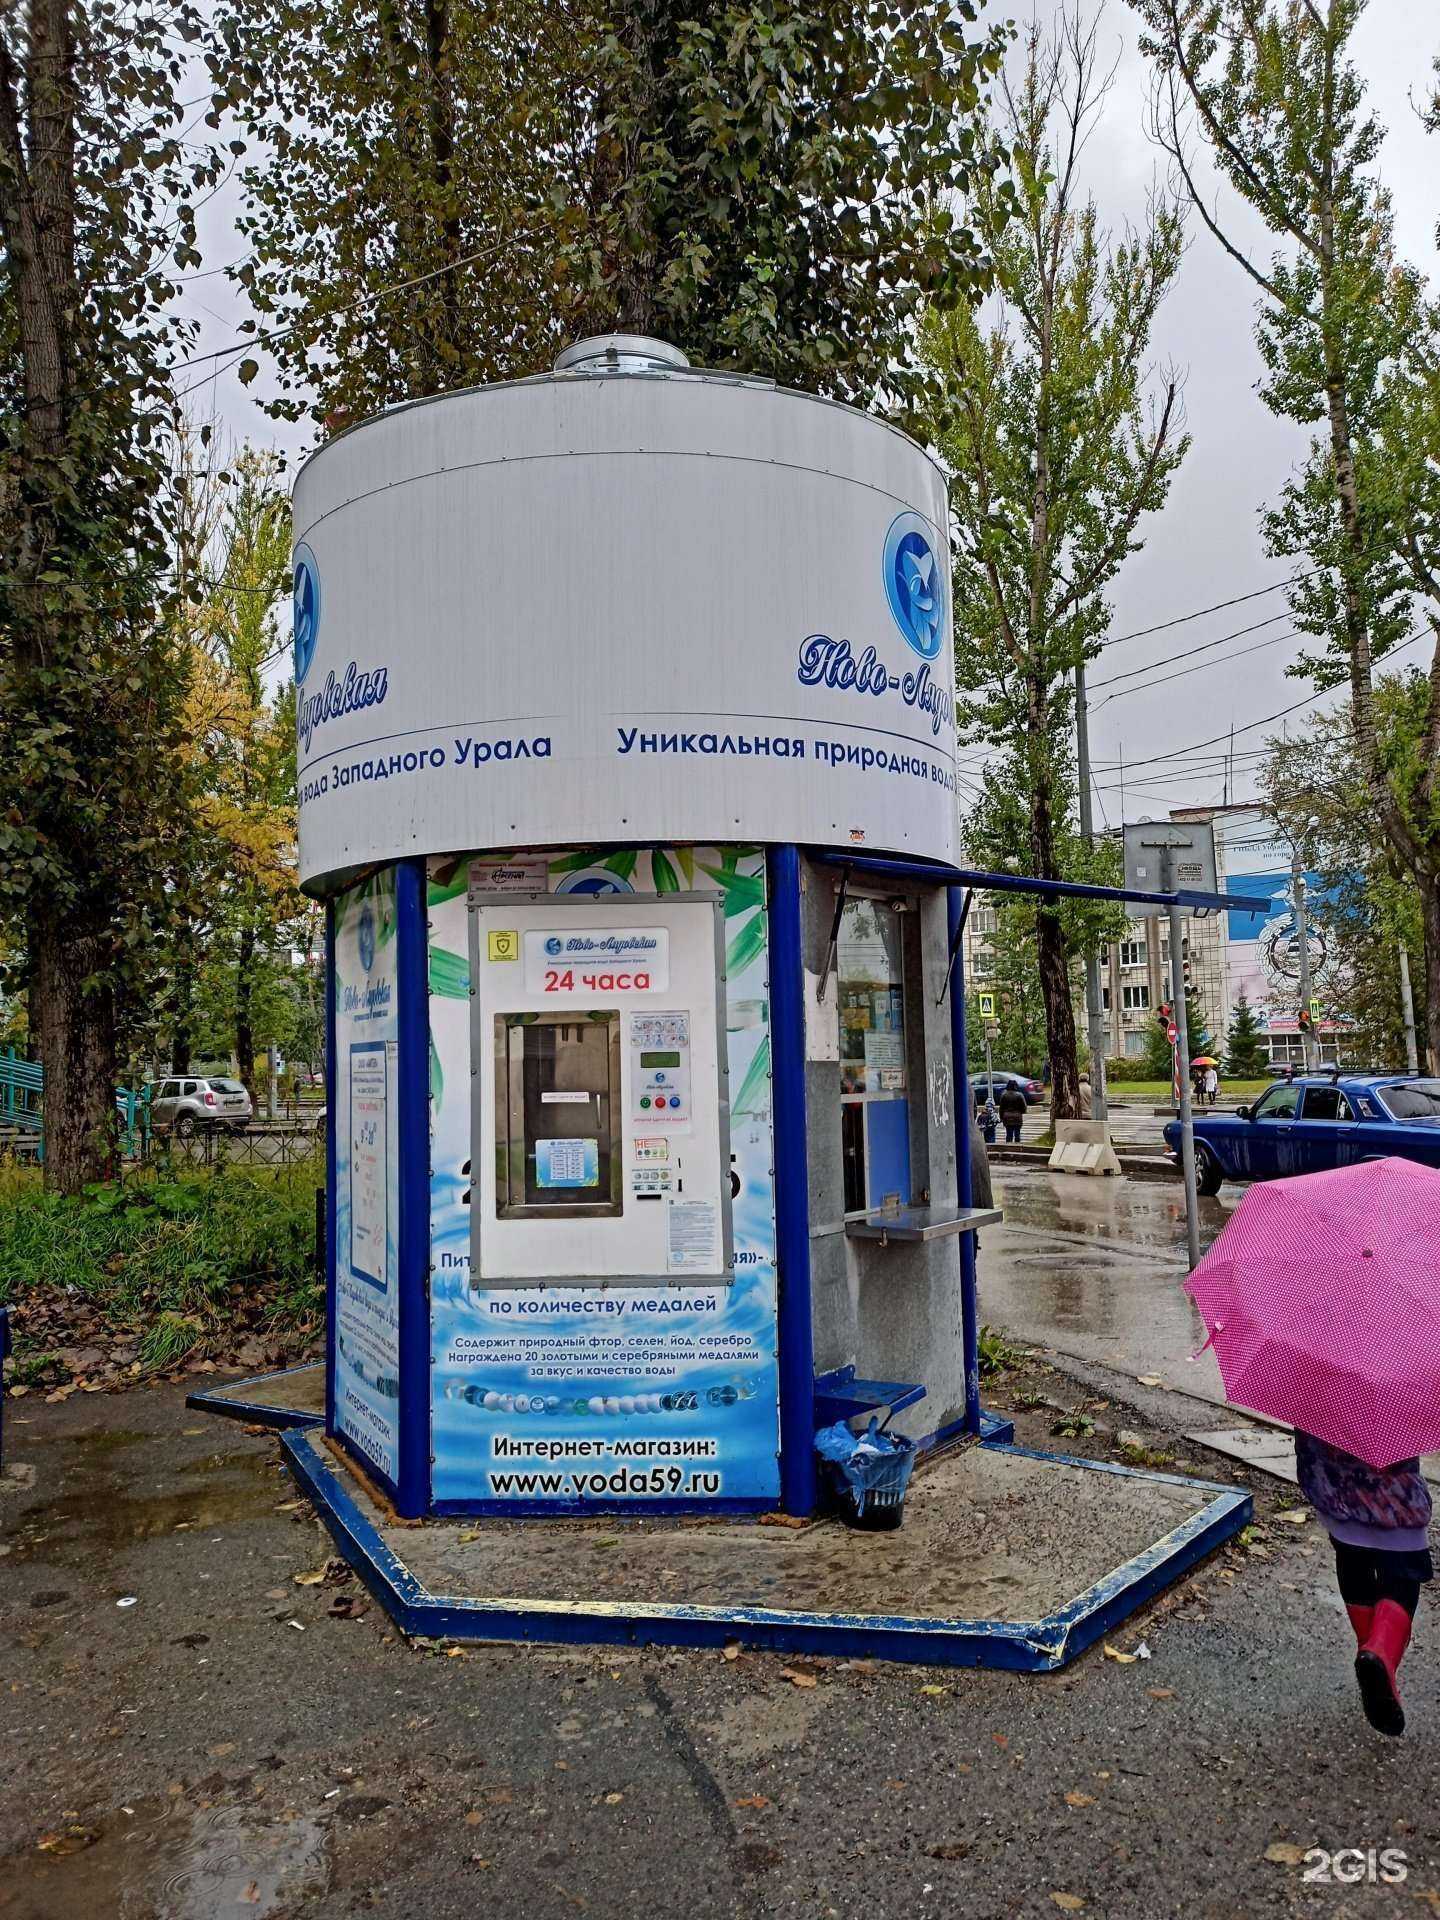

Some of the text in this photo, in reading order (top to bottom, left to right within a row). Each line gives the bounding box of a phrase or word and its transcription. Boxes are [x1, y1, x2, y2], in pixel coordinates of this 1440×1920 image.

[617, 728, 805, 759] Уникальная
[814, 740, 928, 779] природная
[304, 773, 328, 803] вода
[332, 745, 446, 790] Западного
[454, 736, 552, 769] Урала
[544, 970, 650, 992] 24 часа
[441, 1253, 471, 1268] Пит
[489, 1295, 717, 1316] по количеству медалей
[455, 1335, 752, 1349] Содержит природный фтор, селен, йод, серебро
[448, 1350, 760, 1364] Награждена 20 золотыми и серебряными медалями
[530, 1365, 676, 1379] за вкус и качество воды
[493, 1437, 717, 1461] Интернет-магазин:
[490, 1467, 719, 1495] www.voda59.ru
